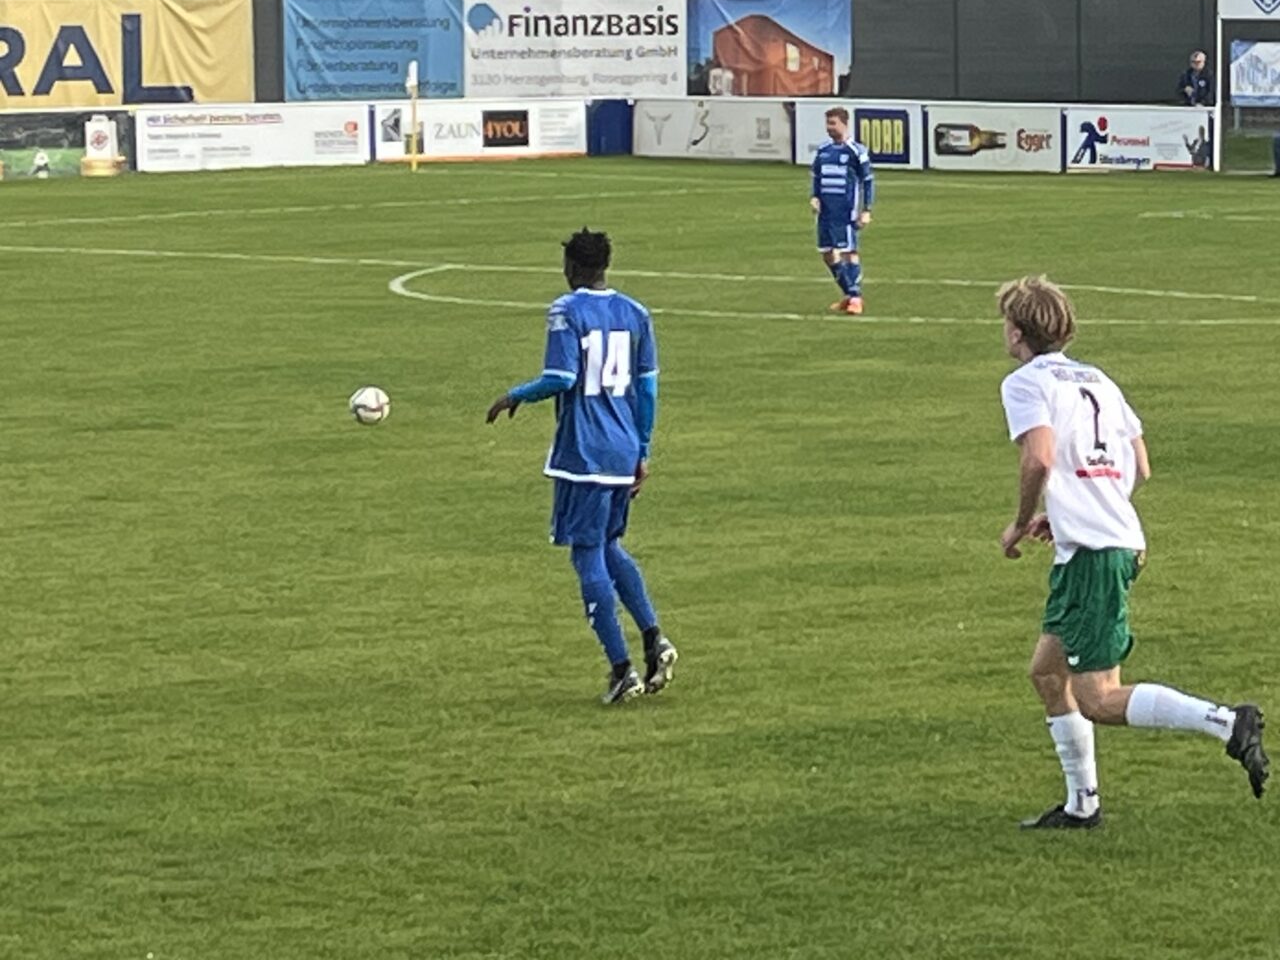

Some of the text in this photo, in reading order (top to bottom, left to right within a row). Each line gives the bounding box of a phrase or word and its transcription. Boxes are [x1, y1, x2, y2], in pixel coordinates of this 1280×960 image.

[0, 13, 194, 104] RAL
[471, 45, 678, 61] Unternehmensberatung GmbH
[581, 329, 631, 396] 14
